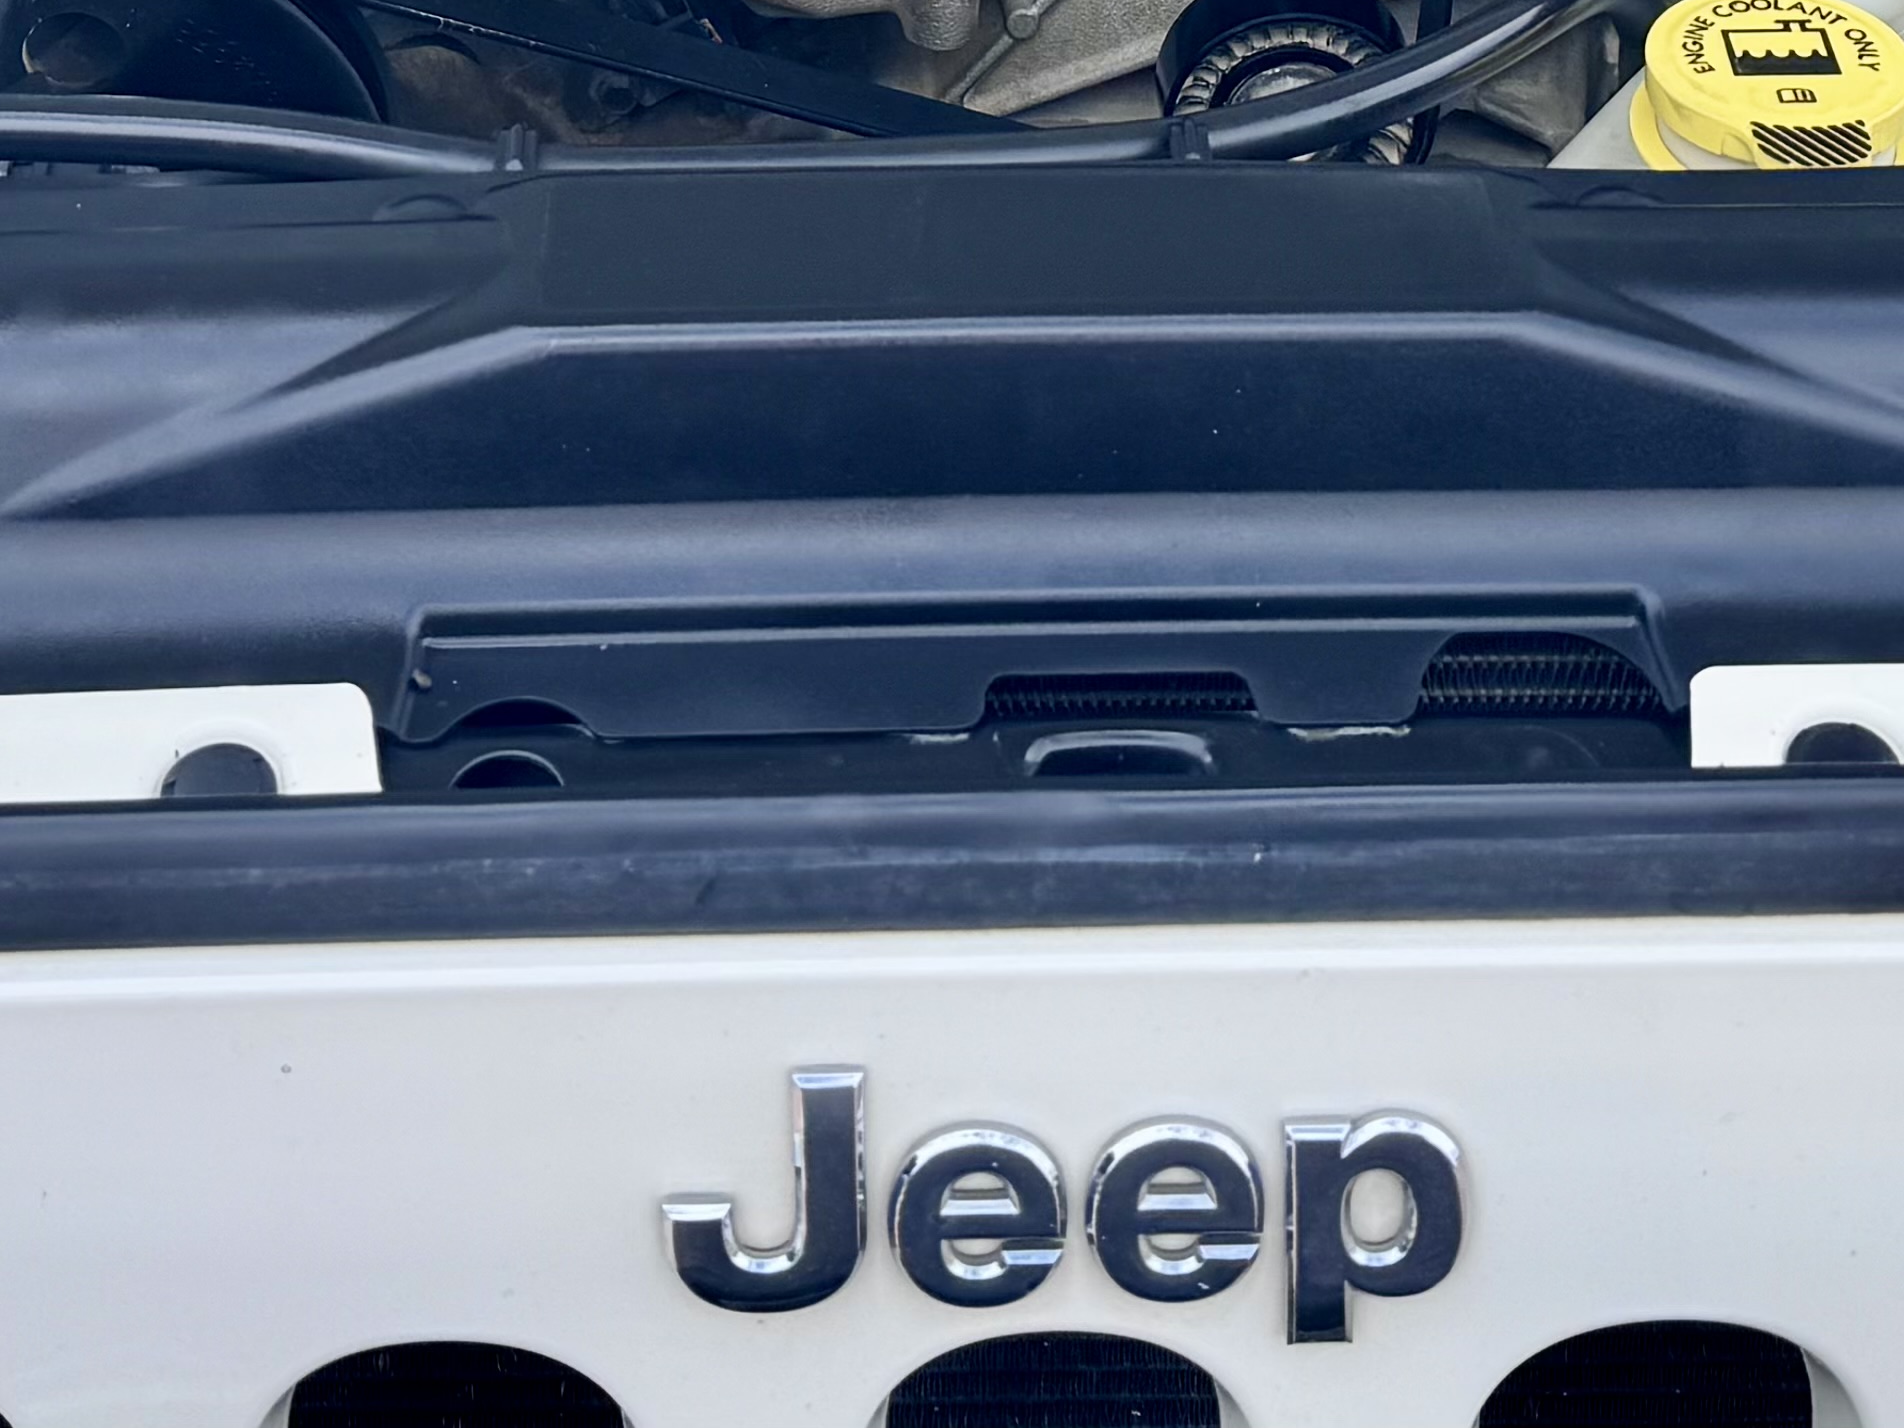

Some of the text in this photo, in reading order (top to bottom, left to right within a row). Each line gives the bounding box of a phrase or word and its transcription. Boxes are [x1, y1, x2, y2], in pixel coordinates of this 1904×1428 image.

[1684, 15, 1716, 76] ENGINE
[1843, 28, 1882, 74] ONLY
[660, 1063, 1472, 1347] Jeep
